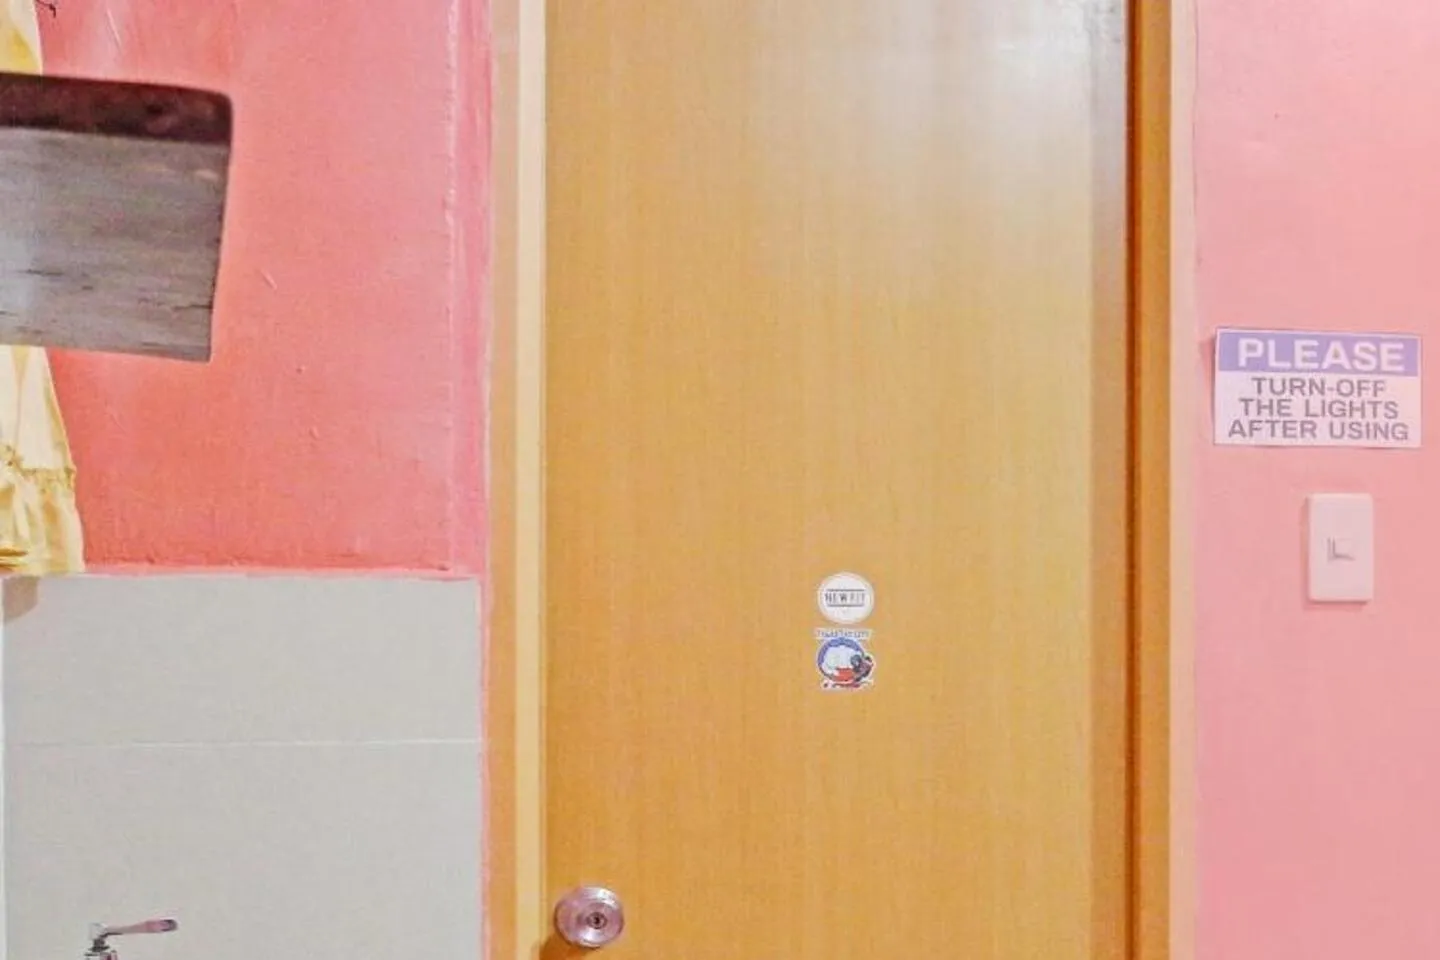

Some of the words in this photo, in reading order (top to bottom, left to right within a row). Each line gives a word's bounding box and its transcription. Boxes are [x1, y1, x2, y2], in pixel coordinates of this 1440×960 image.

[1237, 337, 1405, 372] PLEASE
[1251, 377, 1388, 398] TURN-OFF
[1239, 398, 1293, 418] THE
[1304, 399, 1399, 420] LIGHTS
[1228, 419, 1318, 439] AFTER
[1328, 421, 1410, 441] USING
